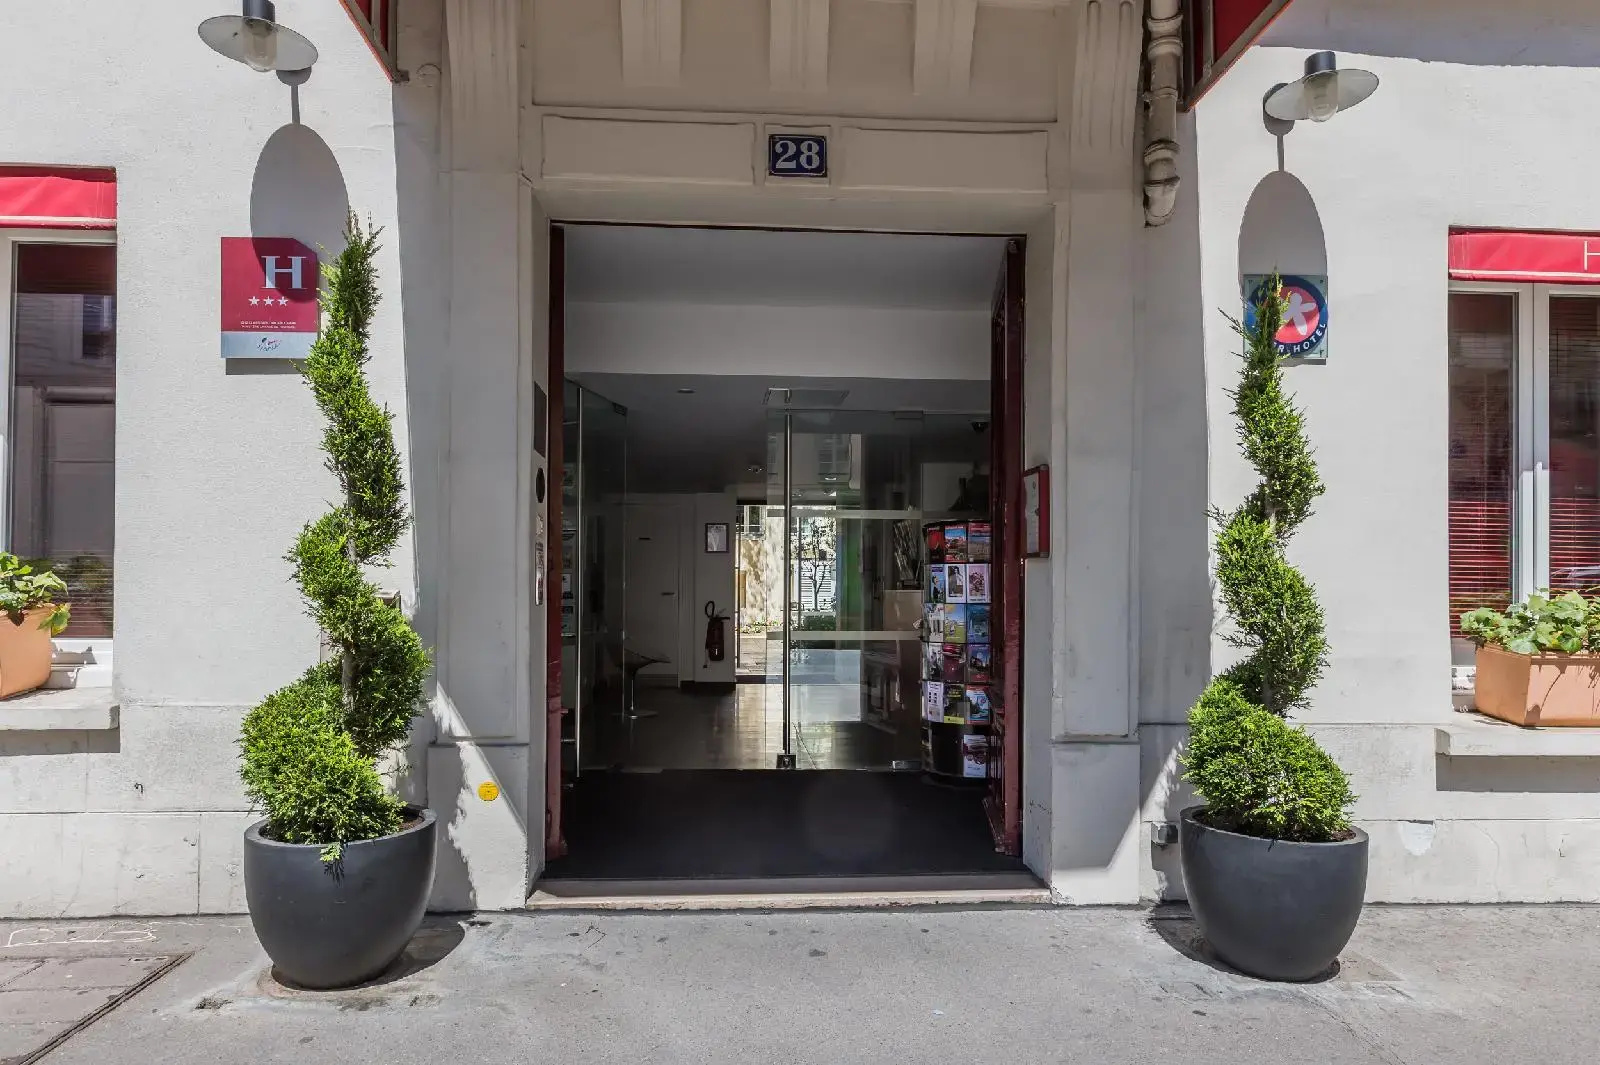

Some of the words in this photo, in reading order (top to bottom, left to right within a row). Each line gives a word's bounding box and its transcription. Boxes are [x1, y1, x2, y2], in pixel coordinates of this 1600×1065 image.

[774, 140, 820, 169] 28
[260, 255, 307, 290] H
[1293, 323, 1326, 353] HOTEL
